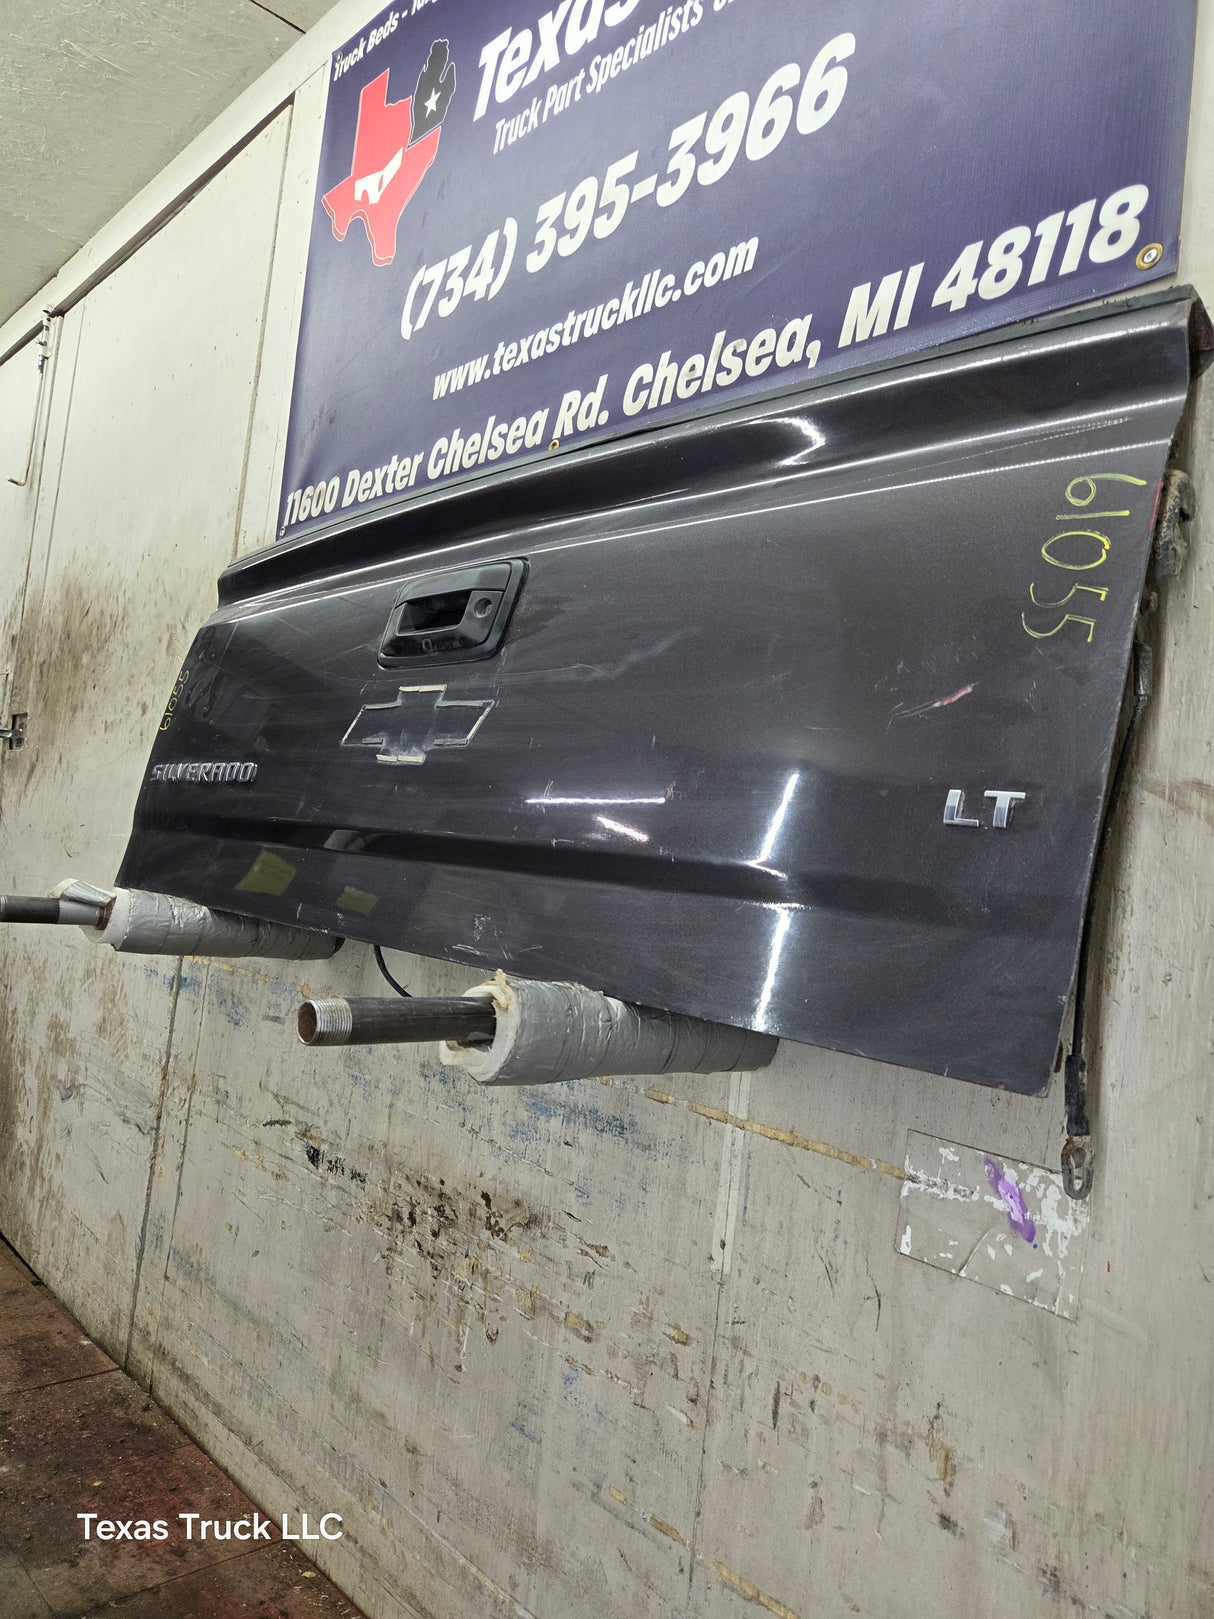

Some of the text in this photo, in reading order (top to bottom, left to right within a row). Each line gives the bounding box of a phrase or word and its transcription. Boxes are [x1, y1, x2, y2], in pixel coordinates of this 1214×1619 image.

[333, 37, 367, 81] Truck
[366, 11, 399, 53] Beds
[493, 0, 704, 155] Truck Part Specialists
[400, 32, 856, 340] (734) 395-3966
[284, 184, 1150, 527] 11600 Dexter Chelsea Rd. Chelsea, MI 48118
[432, 236, 760, 400] www.texastruckllc.com
[1020, 472, 1148, 643] 61055
[150, 761, 259, 783] SILVERADO
[159, 669, 190, 732] 61055
[943, 789, 1027, 829] LT
